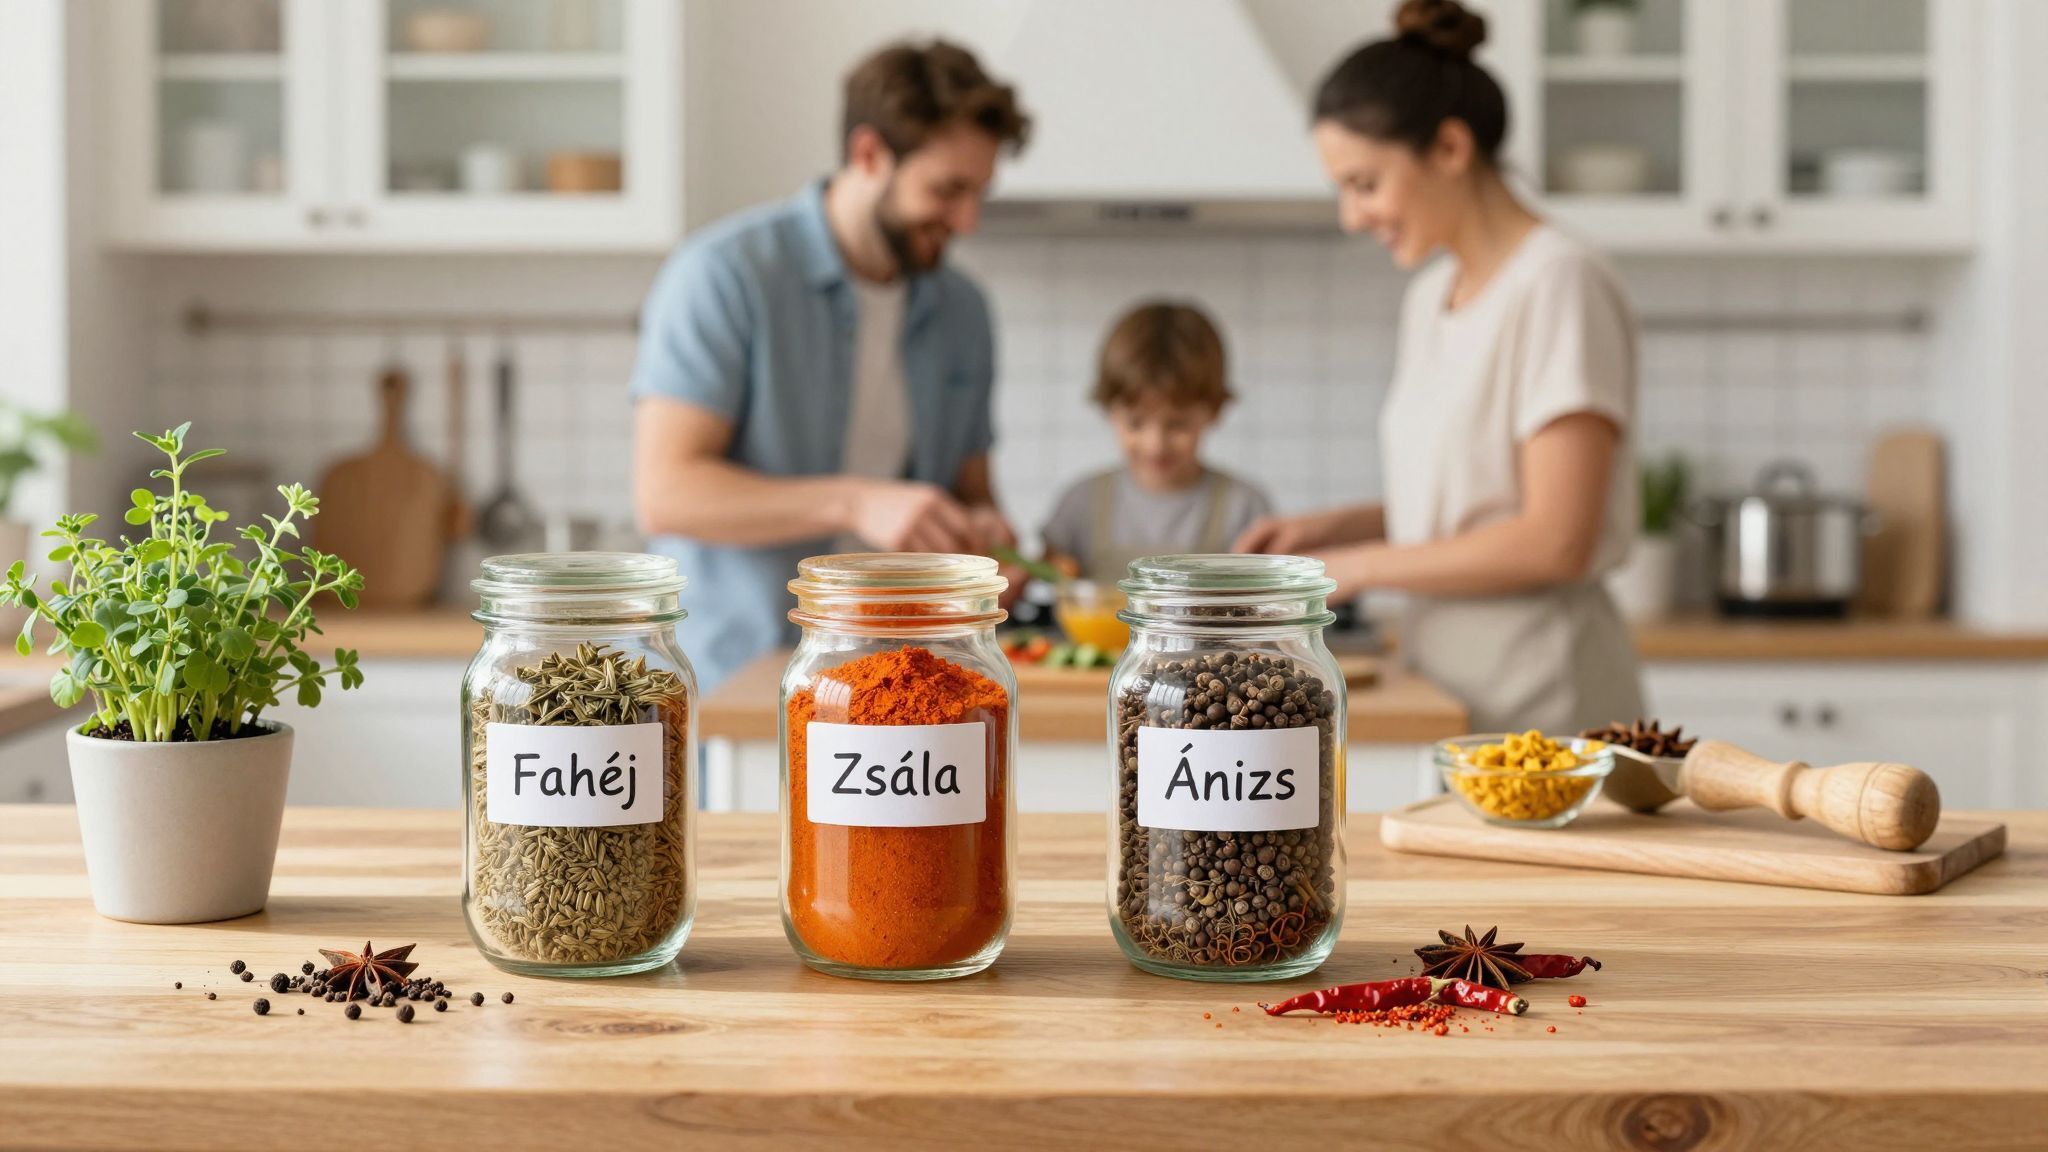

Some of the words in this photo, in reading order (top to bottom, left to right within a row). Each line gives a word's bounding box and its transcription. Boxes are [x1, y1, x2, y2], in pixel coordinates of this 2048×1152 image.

[513, 751, 637, 811] Fahéj
[831, 750, 961, 797] Zsála
[1164, 742, 1296, 802] Ánizs
